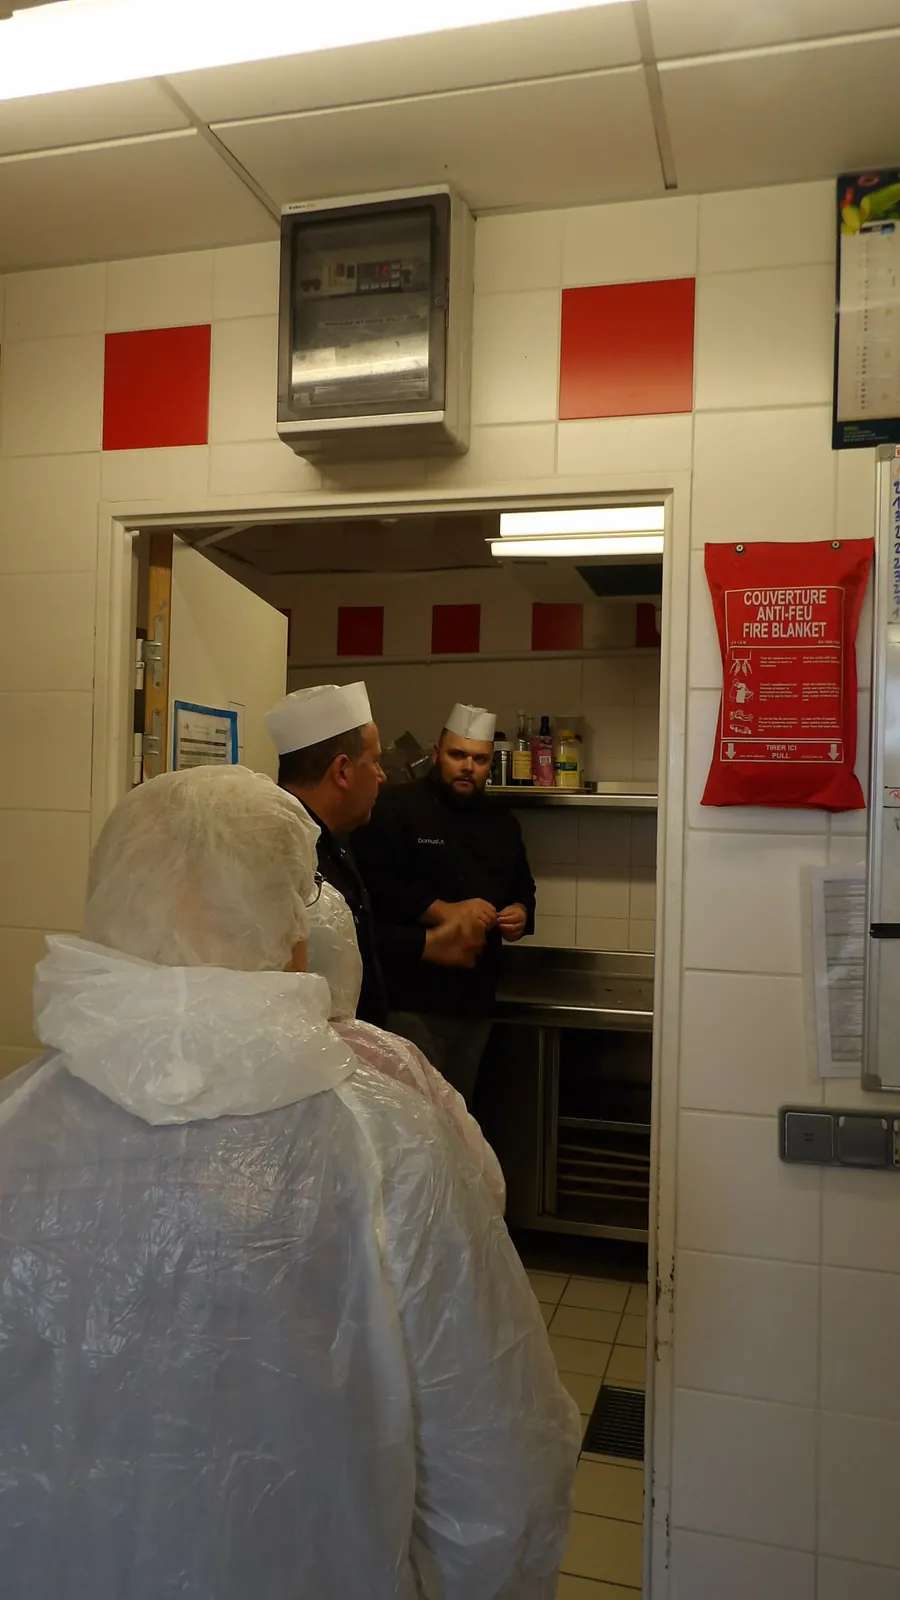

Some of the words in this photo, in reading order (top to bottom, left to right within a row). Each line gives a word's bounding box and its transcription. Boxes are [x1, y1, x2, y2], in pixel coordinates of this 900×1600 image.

[743, 589, 827, 606] COUVERTURE
[756, 605, 812, 621] ANTI-FEU
[743, 622, 769, 638] FIRE
[771, 622, 826, 638] BLANKET
